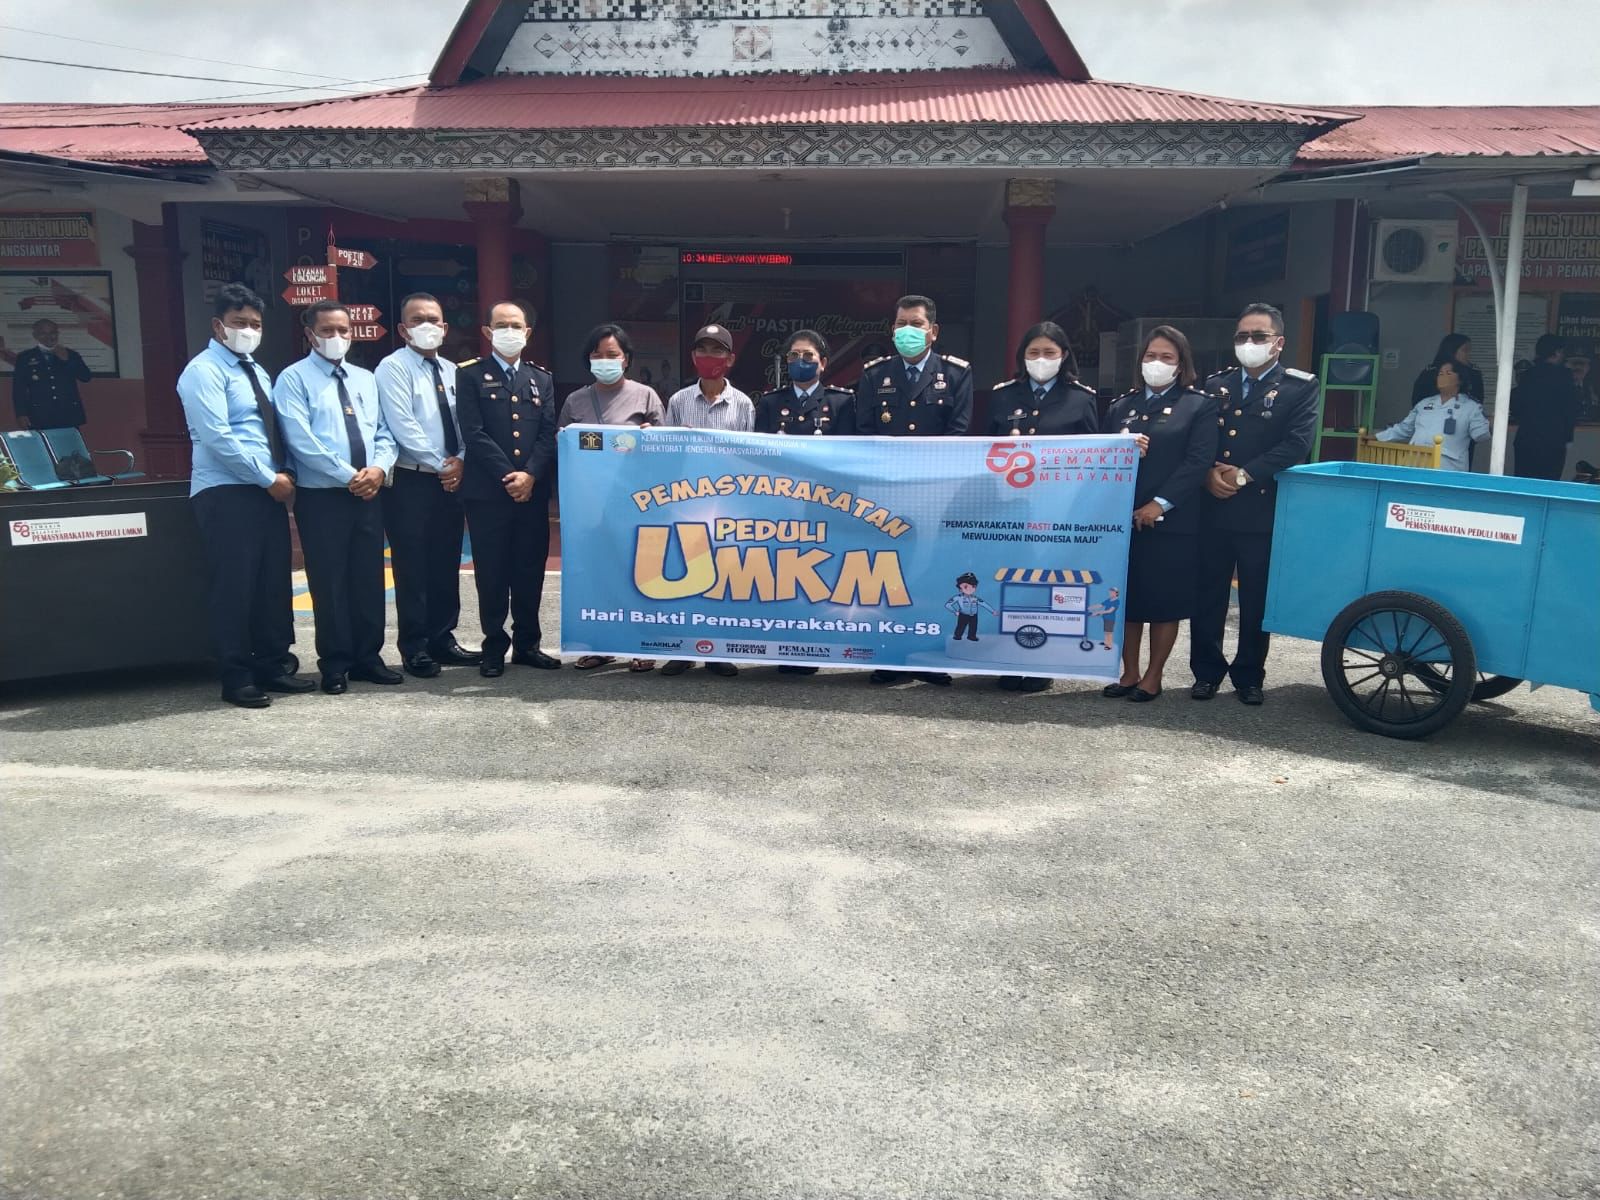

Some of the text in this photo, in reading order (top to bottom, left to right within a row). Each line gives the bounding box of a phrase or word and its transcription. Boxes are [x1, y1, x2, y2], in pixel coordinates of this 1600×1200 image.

[16, 221, 88, 238] PENGUNJUNG
[0, 244, 61, 257] ANGSIANTAR
[292, 267, 325, 277] LAYANAN
[296, 286, 322, 297] LOKET
[350, 326, 379, 338] ILET
[641, 433, 689, 443] KEMENTERIAN
[690, 435, 715, 444] HUKUM
[641, 444, 682, 453] DIREKTORAT
[718, 446, 782, 456] PEMASYARAKATAN
[1040, 455, 1134, 465] SEMAKIN
[1039, 472, 1133, 482] MELAYANI
[631, 474, 913, 540] PEMASYARAKATAN
[714, 517, 828, 544] PEDULI
[1026, 522, 1050, 531] PASTI
[1053, 523, 1072, 532] DAN
[1074, 524, 1125, 534] BerAKHLAK,
[1405, 520, 1518, 542] PEMASYARAKATAN PEDULI UMKM
[32, 527, 143, 543] PEMASYARAKATAN PEDULI UMKM
[962, 532, 1023, 542] MEWUJUDKAN
[1024, 534, 1072, 544] INDONESIA
[633, 522, 912, 608] UMKM
[581, 608, 942, 636] Hari Bakti Pemasyarakatan Ke-58
[778, 645, 831, 654] PEMAJUAN
